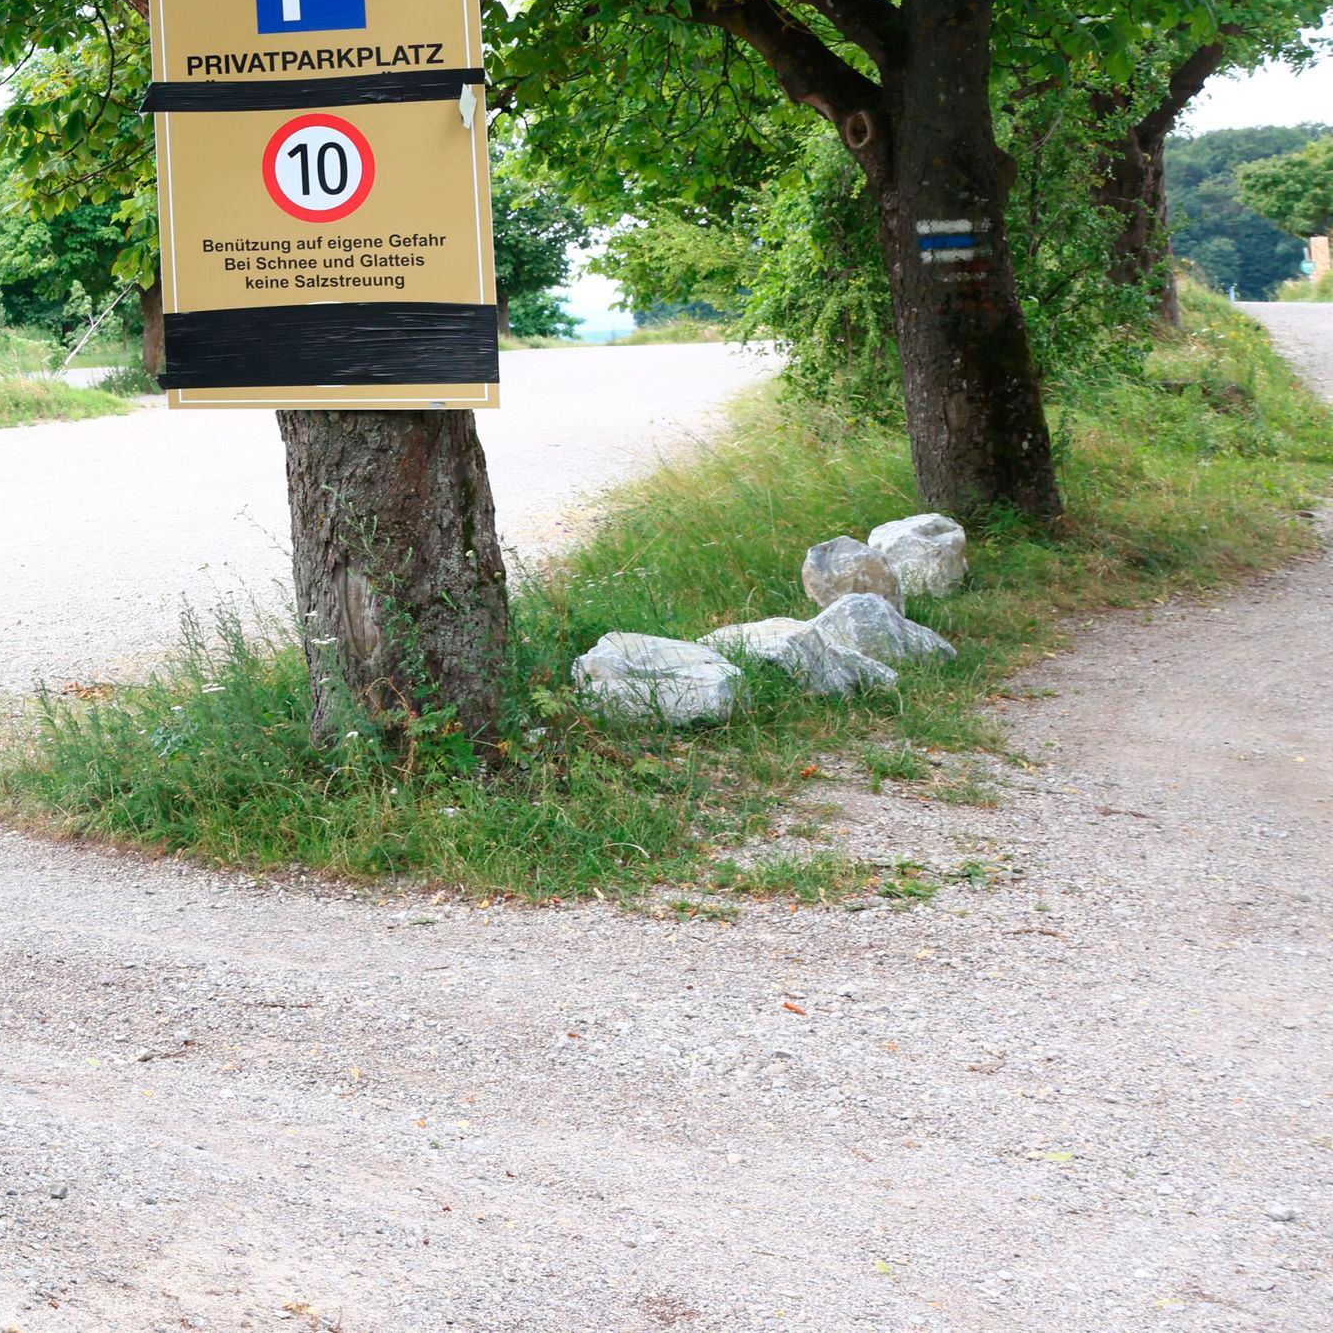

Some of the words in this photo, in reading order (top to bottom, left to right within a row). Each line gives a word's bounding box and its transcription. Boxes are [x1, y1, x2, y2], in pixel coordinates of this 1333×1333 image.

[187, 43, 444, 76] PRIVATPARKPLATZ
[286, 141, 348, 196] 10
[202, 239, 291, 253] Benützung
[296, 236, 322, 250] auf
[327, 236, 383, 252] eigene
[388, 234, 446, 248] Gefahr
[224, 257, 251, 271] Bei
[256, 256, 318, 270] Schnee
[323, 255, 354, 269] und
[360, 253, 425, 268] Glatteis
[245, 275, 290, 289] keine
[294, 274, 405, 290] Salzstreuung
